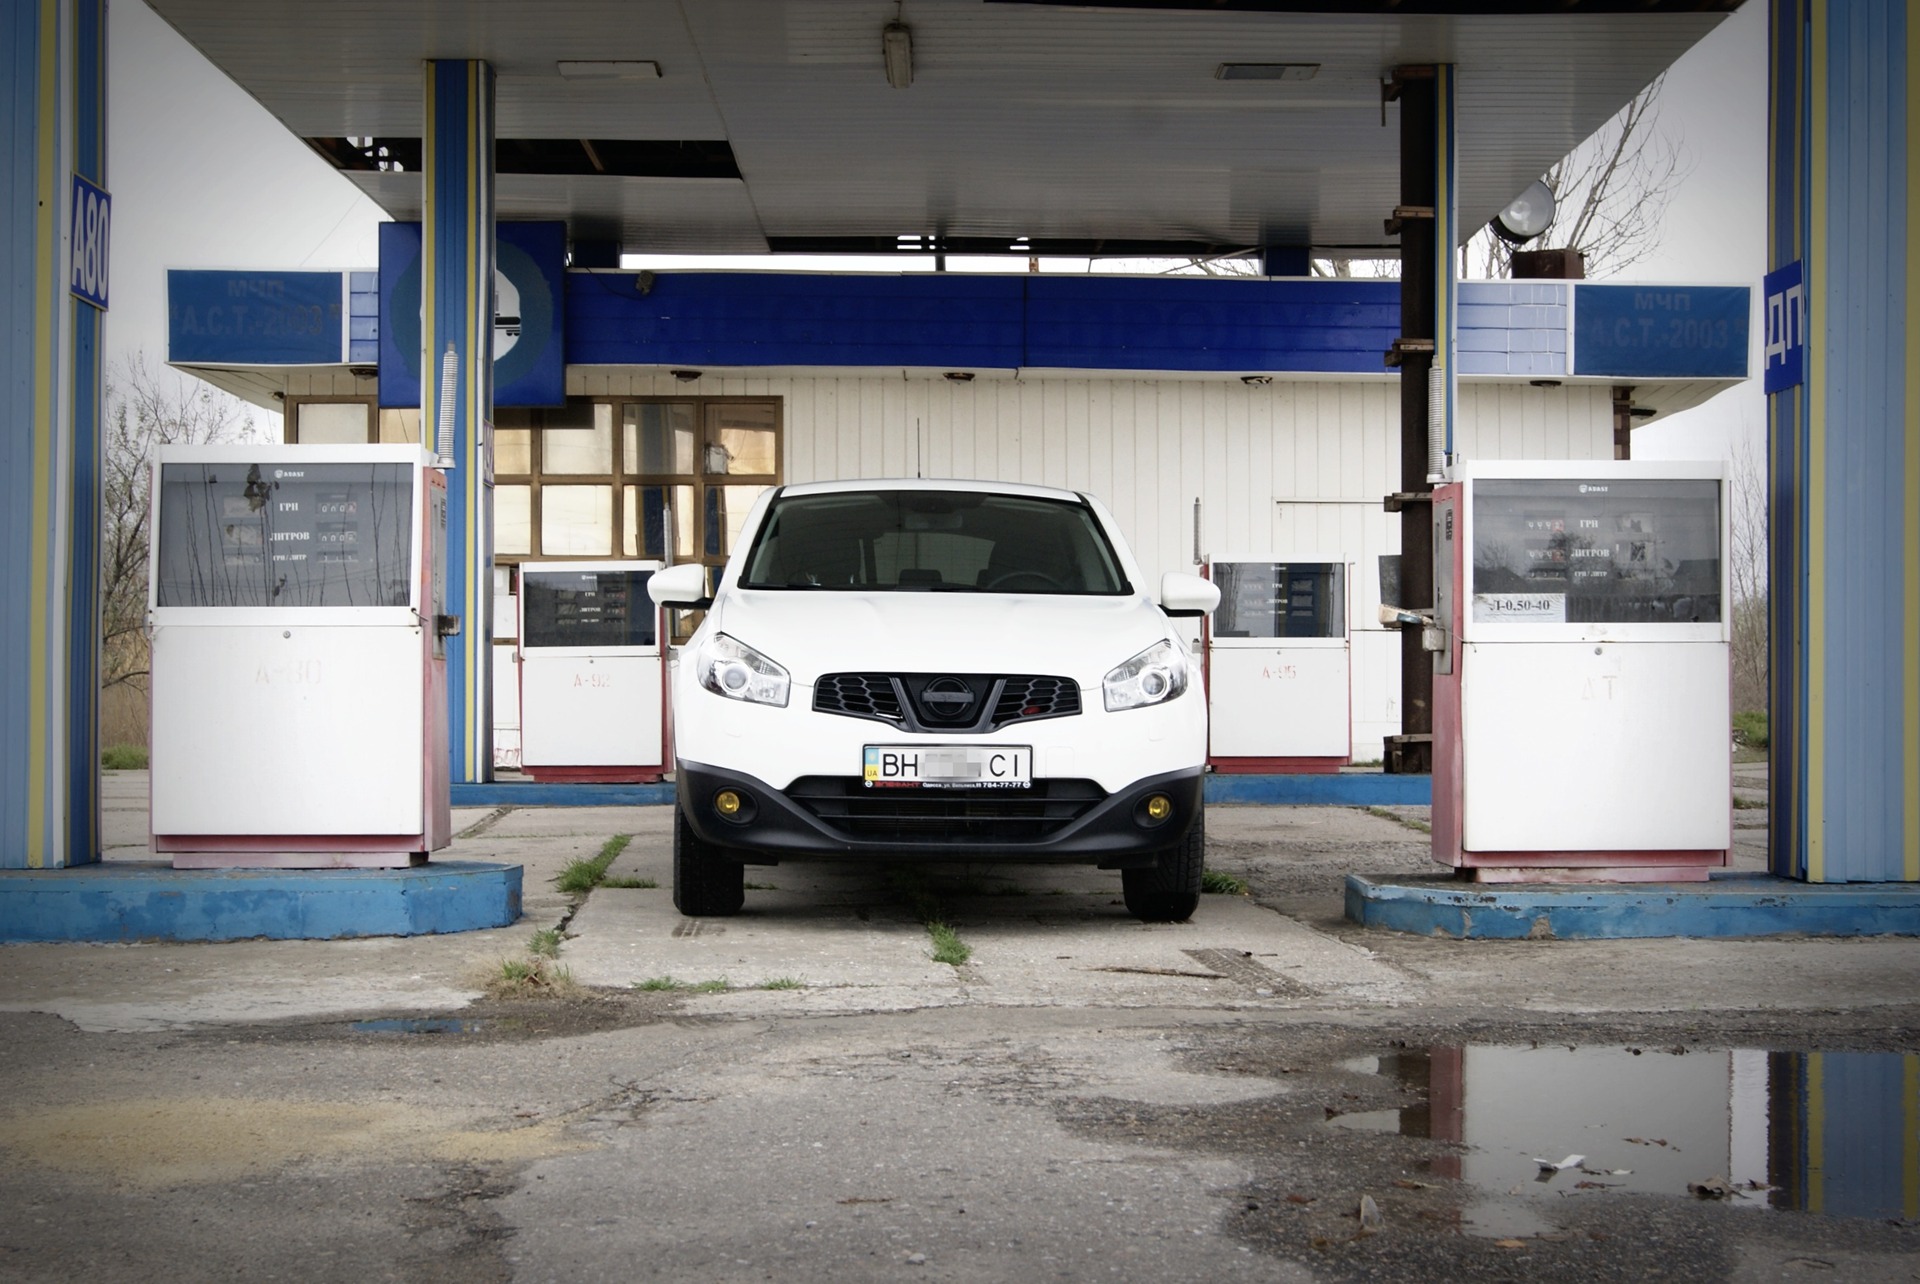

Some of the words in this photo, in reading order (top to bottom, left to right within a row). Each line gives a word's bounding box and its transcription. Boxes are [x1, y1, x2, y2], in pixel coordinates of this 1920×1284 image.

[71, 185, 109, 301] А80
[1635, 292, 1691, 311] МЧП
[1765, 283, 1802, 370] ДП
[280, 502, 299, 512] ГРН
[1579, 519, 1599, 528] ГРН
[269, 531, 311, 542] ЛИТРОВ
[1571, 548, 1610, 558] ЛИТРОВ
[883, 753, 918, 777] BH
